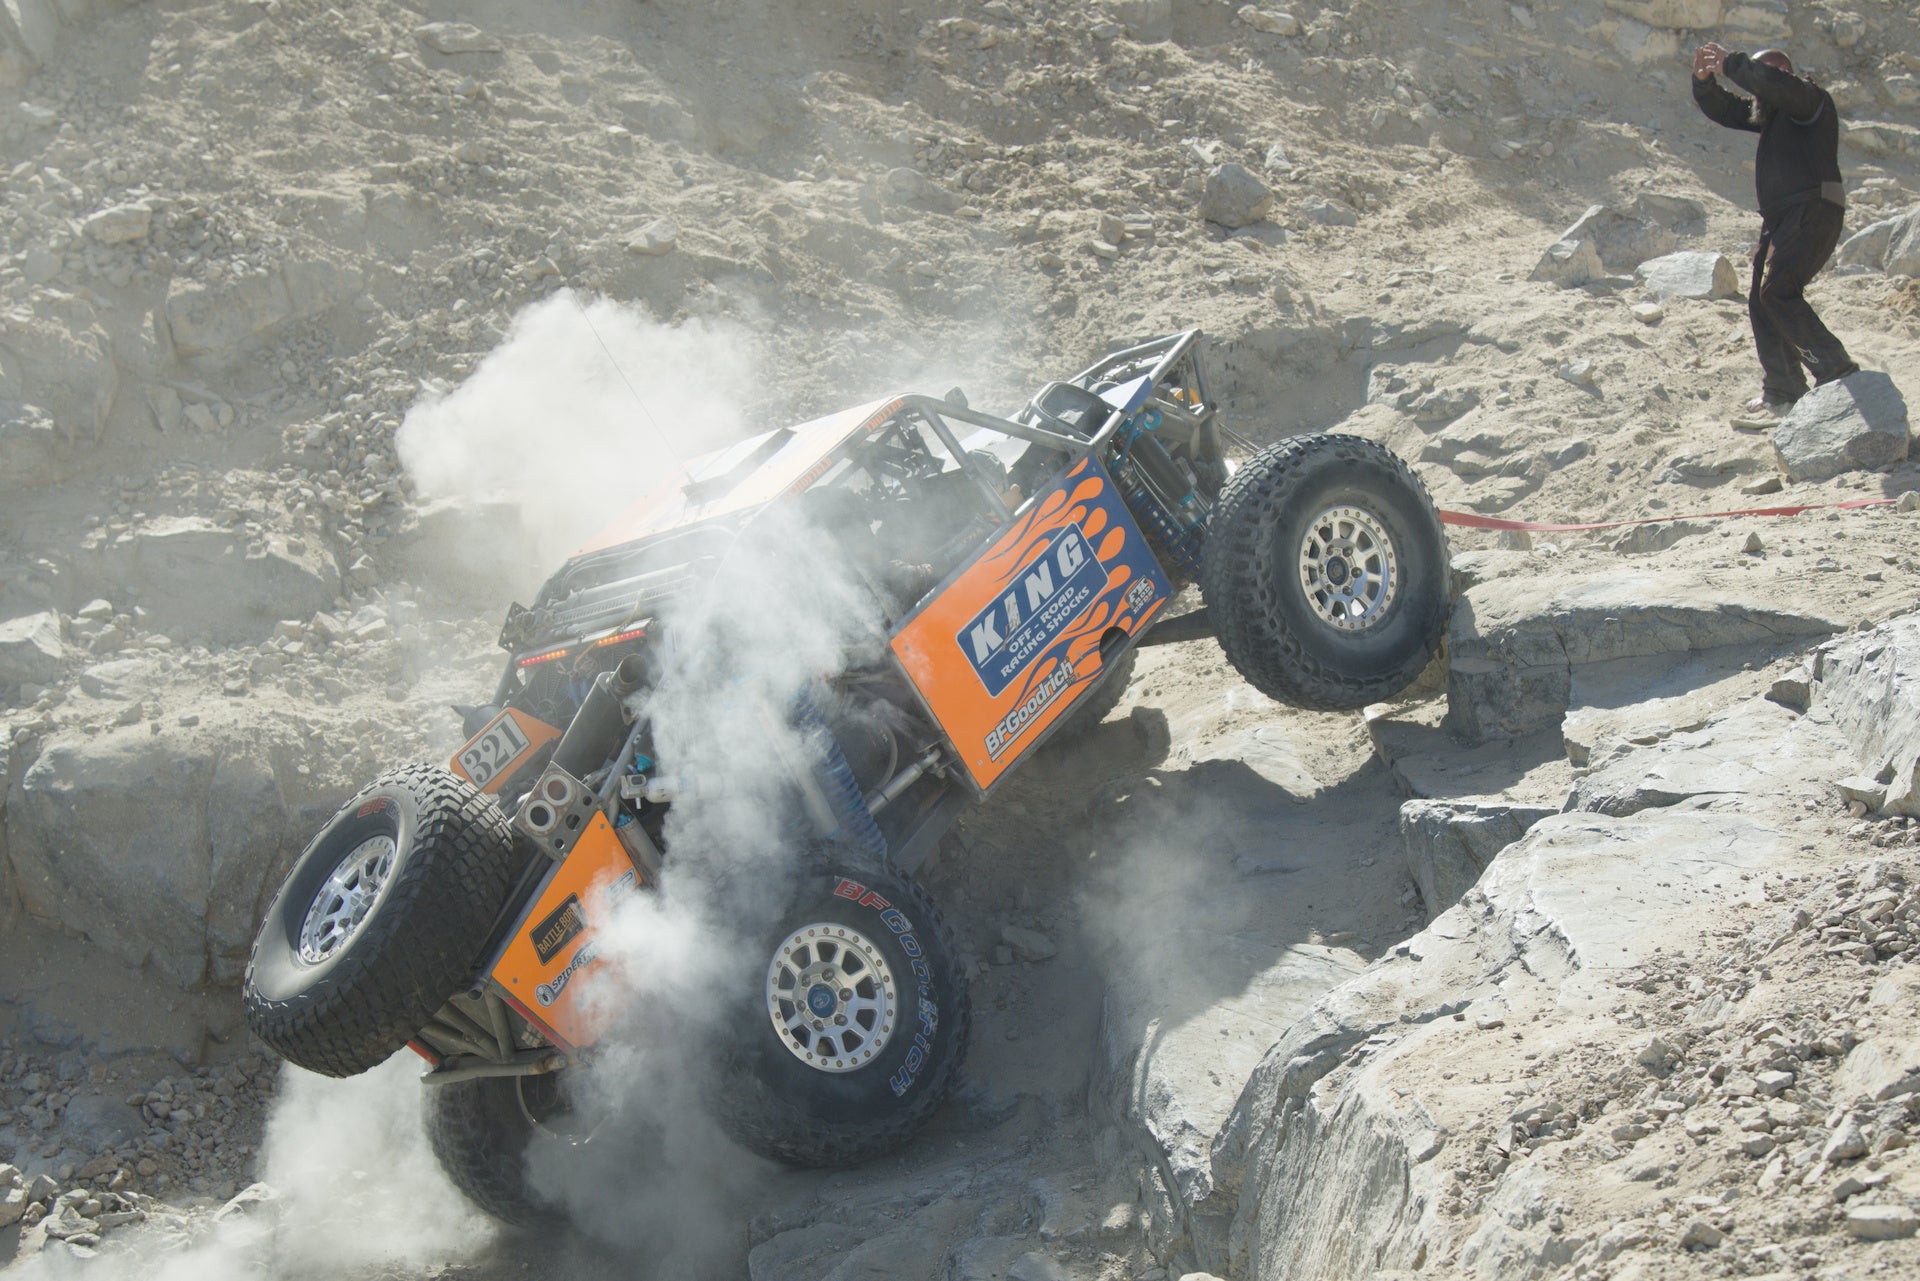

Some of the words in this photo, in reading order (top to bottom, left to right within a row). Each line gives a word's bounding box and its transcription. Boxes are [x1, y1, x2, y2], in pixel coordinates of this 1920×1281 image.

[970, 532, 1084, 664] KING
[1000, 631, 1046, 677] RACING
[1046, 586, 1091, 632] SHOCKS
[1008, 629, 1034, 654] OFF
[1040, 586, 1076, 624] ROAD
[984, 660, 1073, 756] BFGoodrich
[463, 718, 526, 783] 321
[537, 923, 564, 955] BATTLE
[550, 948, 594, 991] SPIDERT
